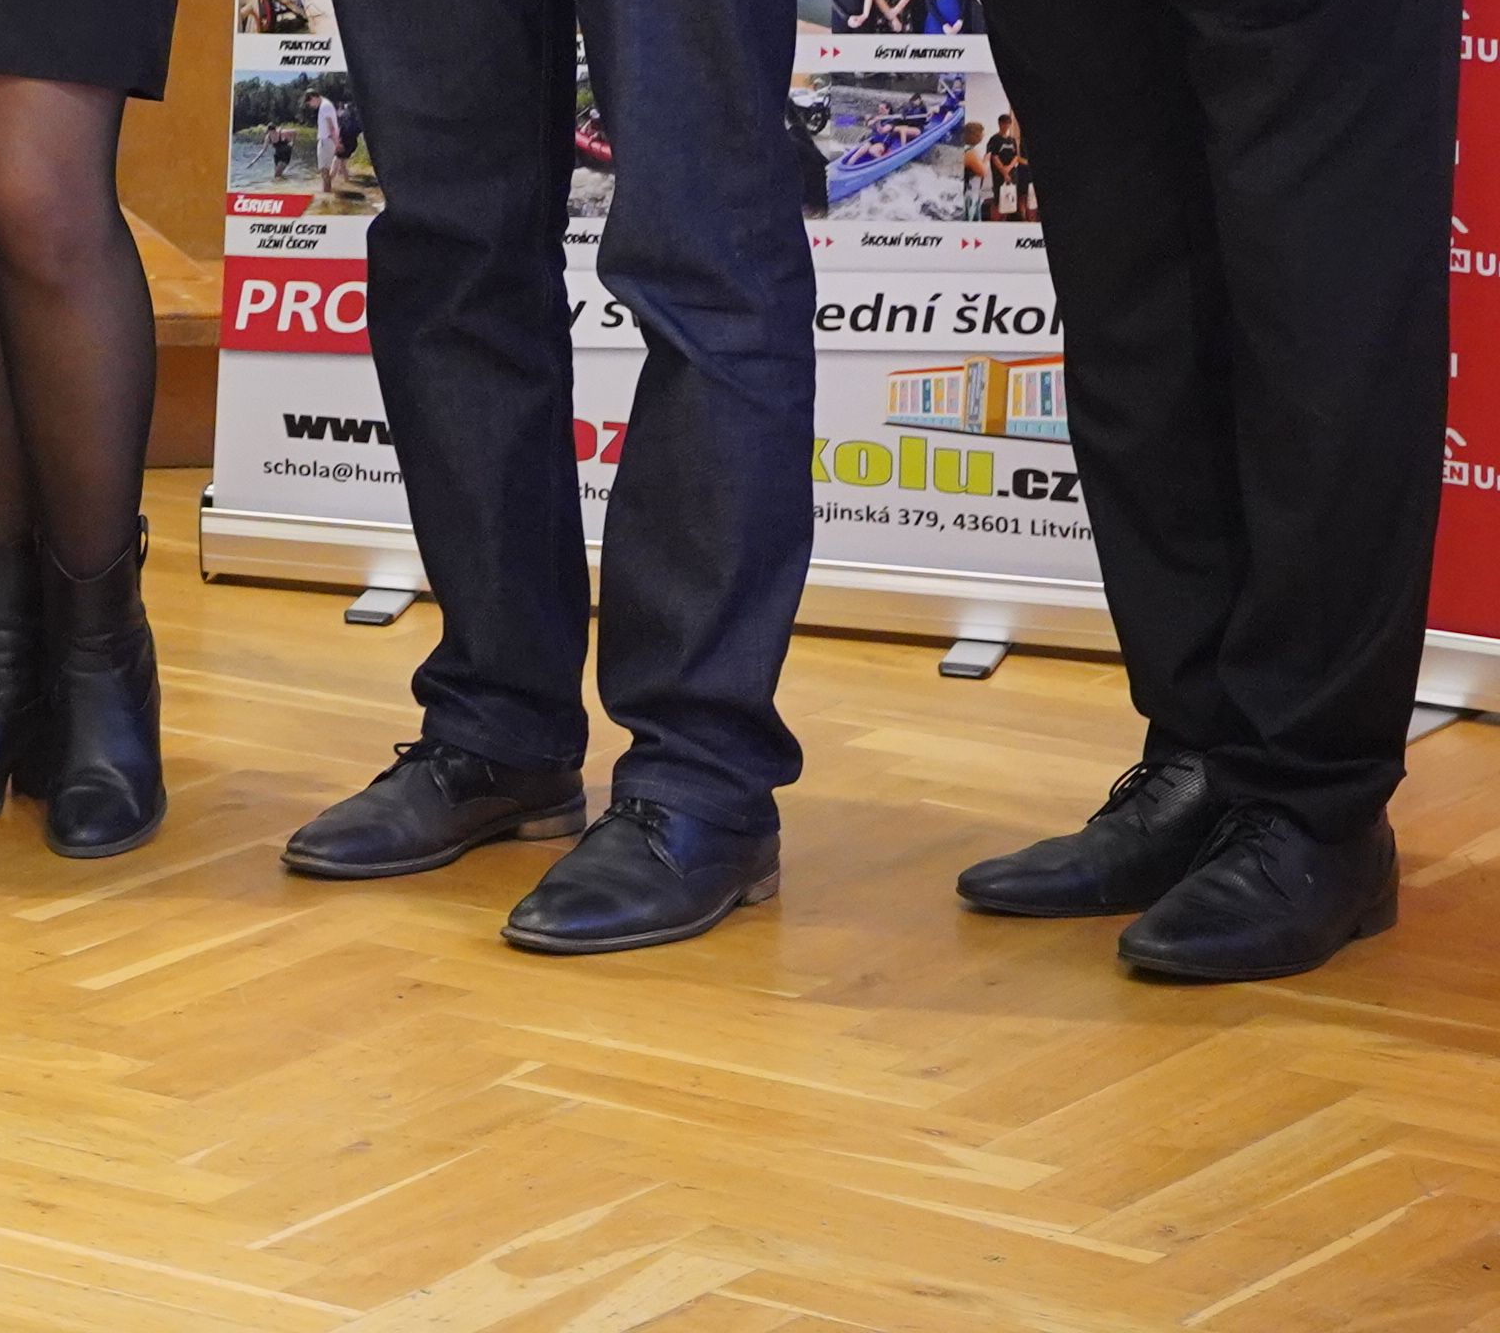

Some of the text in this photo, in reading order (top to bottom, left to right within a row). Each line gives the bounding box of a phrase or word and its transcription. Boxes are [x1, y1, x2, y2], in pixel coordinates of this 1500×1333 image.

[279, 38, 332, 51] PRAKTICKÉ
[874, 45, 965, 59] ÚSTNÍ MATURITY
[280, 56, 331, 65] MATURITY
[234, 194, 284, 213] ČERVEN
[250, 223, 327, 234] STUDIJNÍ CESTA
[256, 234, 318, 249] JIŽNÍ ČECHY
[861, 232, 943, 247] ŠKOLNÍ VÝLETY
[234, 280, 366, 334] PRO
[816, 291, 1063, 335] ední škol
[263, 458, 402, 484] schola@hum
[898, 510, 946, 532] 379,
[952, 513, 1020, 535] 43601
[1030, 520, 1092, 541] Litvín
